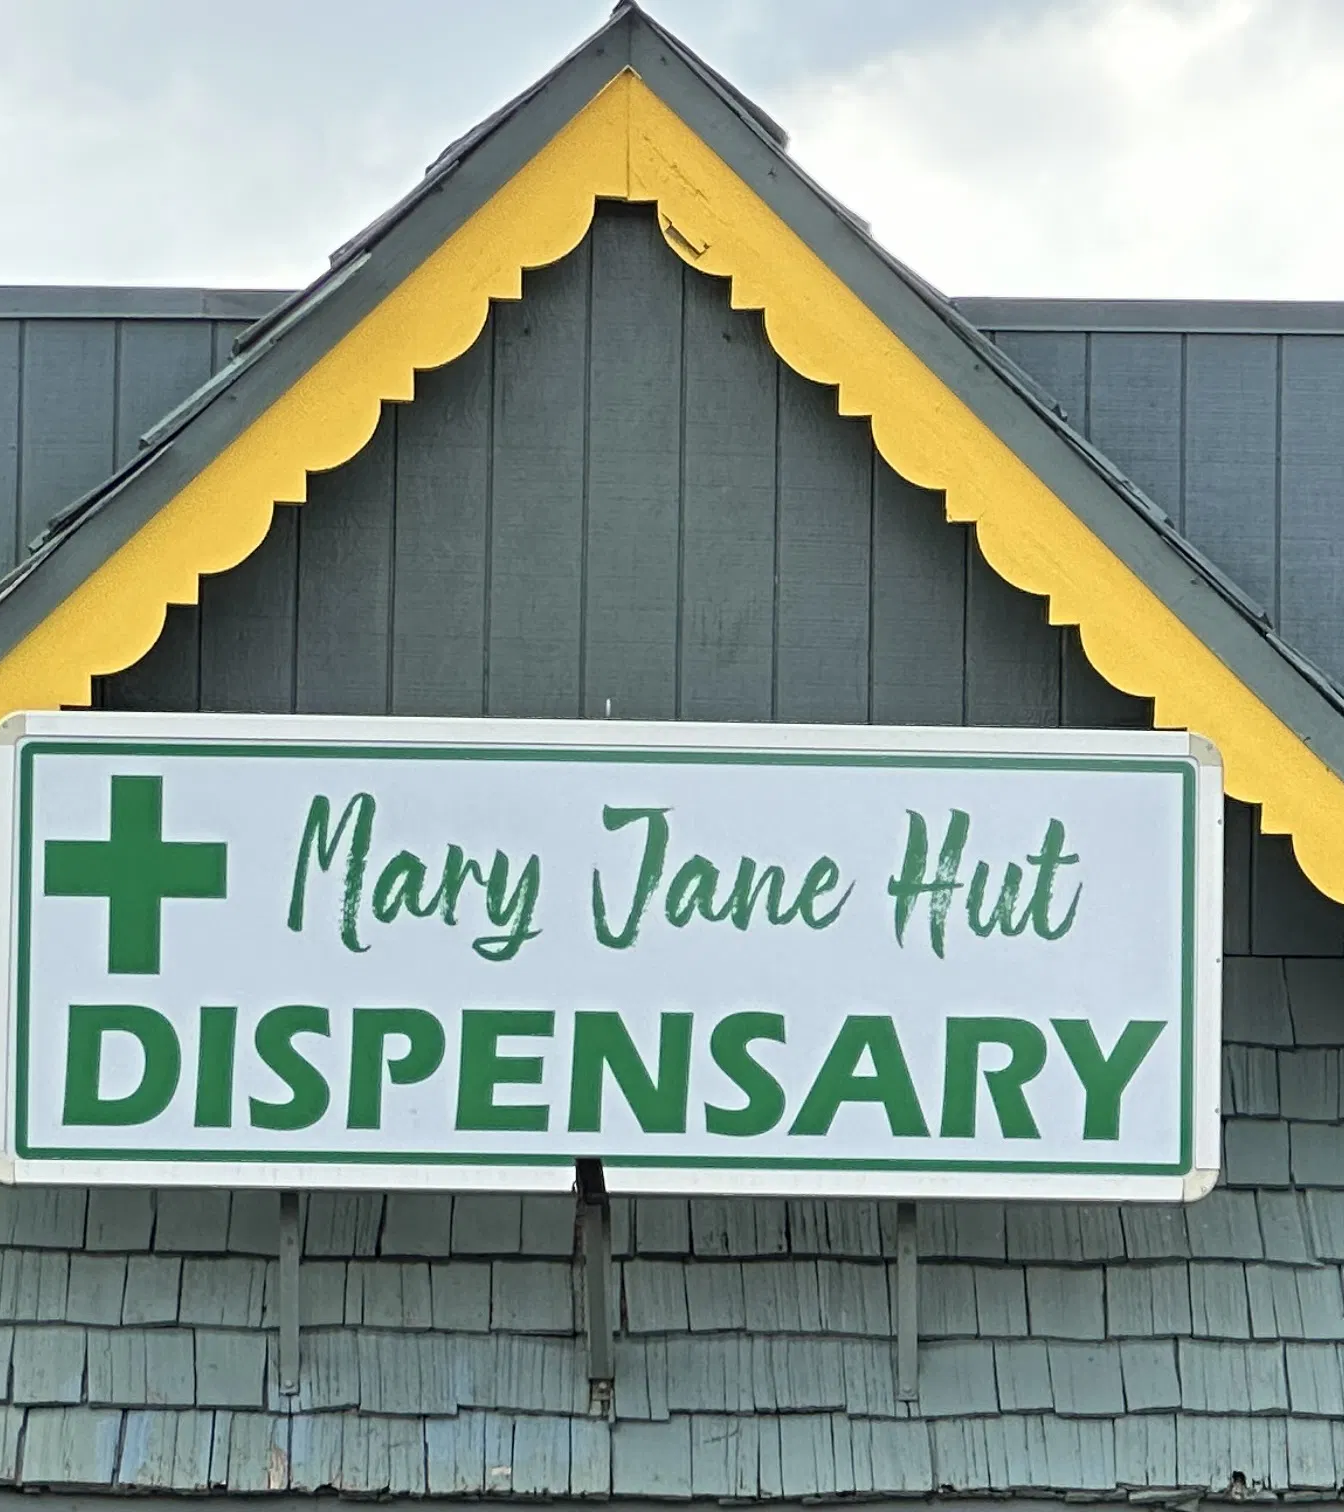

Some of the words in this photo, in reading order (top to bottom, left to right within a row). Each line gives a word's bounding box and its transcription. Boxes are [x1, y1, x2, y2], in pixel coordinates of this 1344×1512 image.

[287, 792, 542, 961] Mary
[591, 803, 854, 951] Jane
[887, 806, 1084, 960] Hut
[62, 1002, 1170, 1142] DISPENSARY
